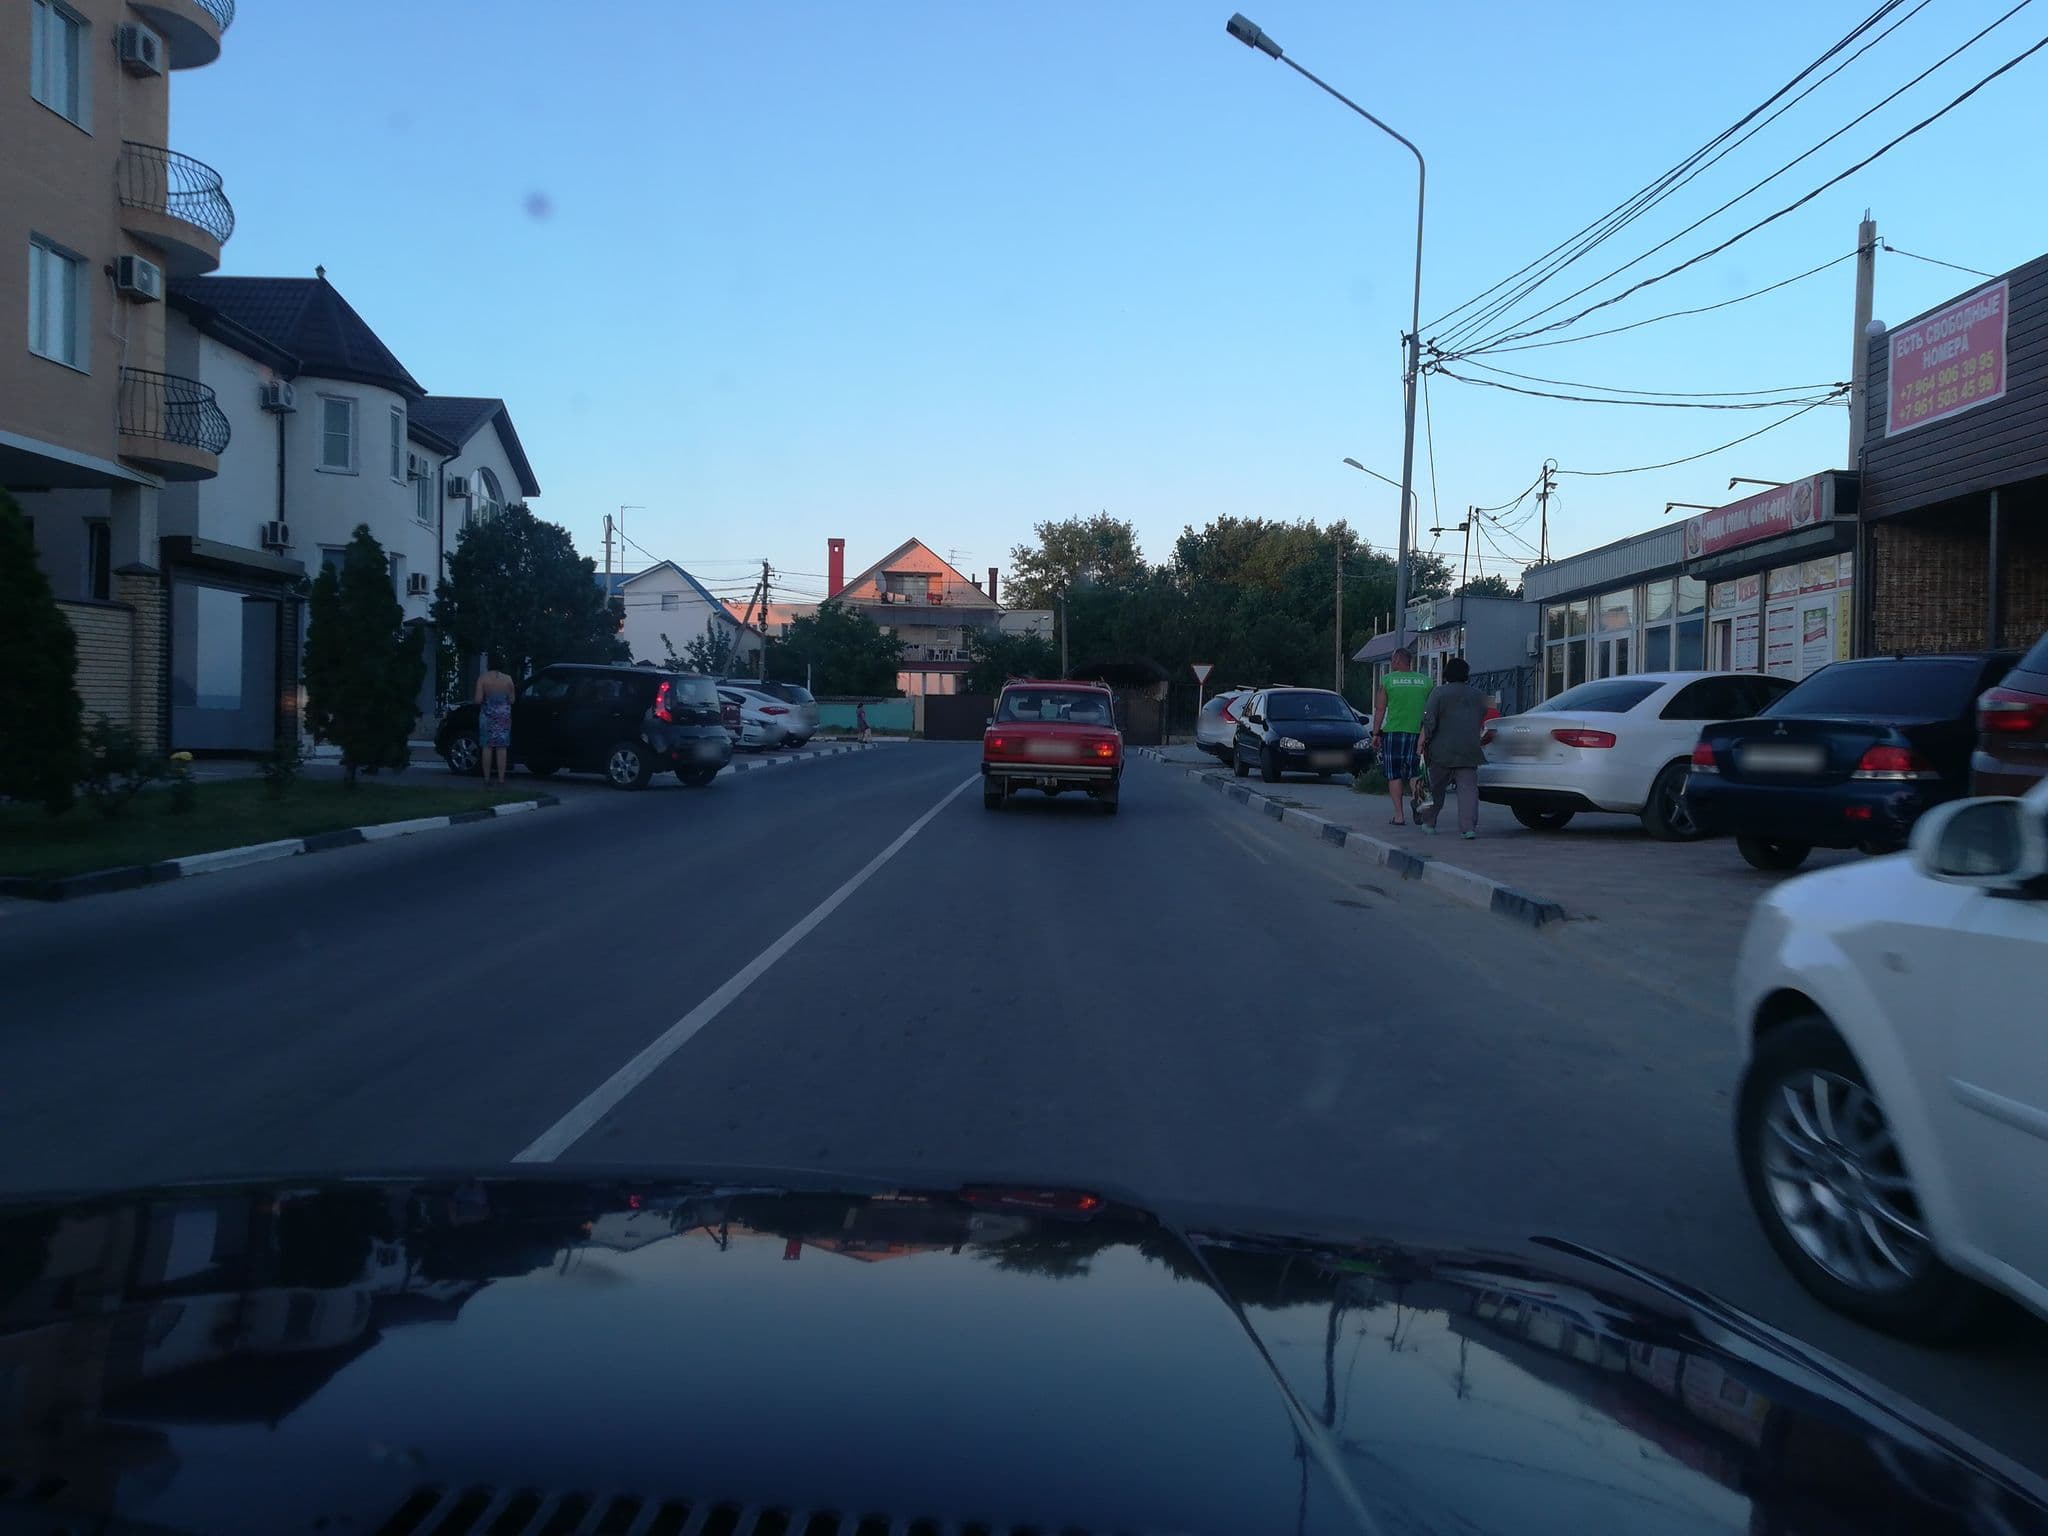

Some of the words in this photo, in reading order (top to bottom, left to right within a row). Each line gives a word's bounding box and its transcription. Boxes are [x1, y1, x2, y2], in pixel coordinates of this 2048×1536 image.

[1896, 332, 1924, 359] ЕСТЬ
[1926, 294, 2000, 345] СВОБОДНЫЕ
[1922, 333, 1969, 369] НОМЕРА
